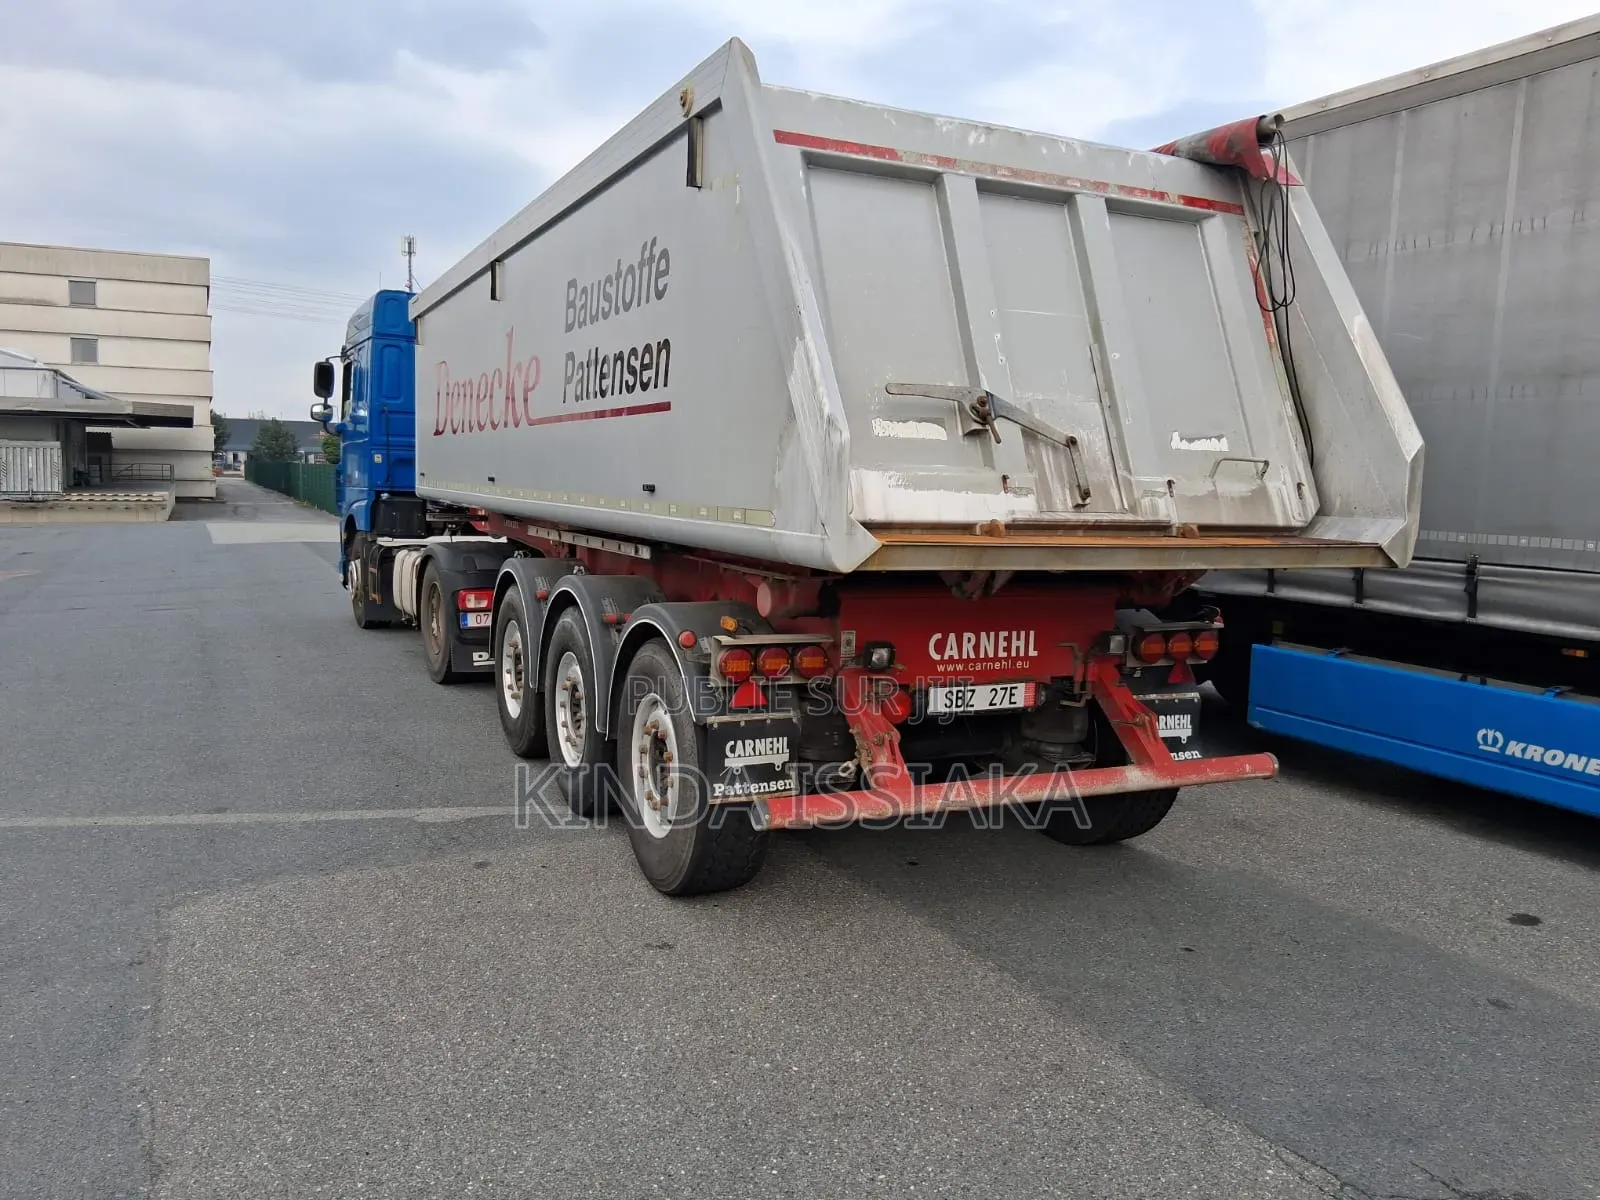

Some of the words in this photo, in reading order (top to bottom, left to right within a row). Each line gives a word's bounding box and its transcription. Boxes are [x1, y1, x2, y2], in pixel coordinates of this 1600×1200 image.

[564, 236, 671, 334] Baustoffe
[433, 325, 542, 436] Denecke
[562, 337, 672, 404] Pattensen
[928, 630, 1039, 661] CARNEHL
[936, 659, 1030, 673] www.carnehl.eu
[944, 688, 976, 709] SBZ
[988, 686, 1019, 707] 27E
[1157, 713, 1193, 730] RNEHL
[725, 736, 790, 758] CARNEHL
[1504, 740, 1600, 776] KRONE
[712, 776, 796, 797] Pattensen
